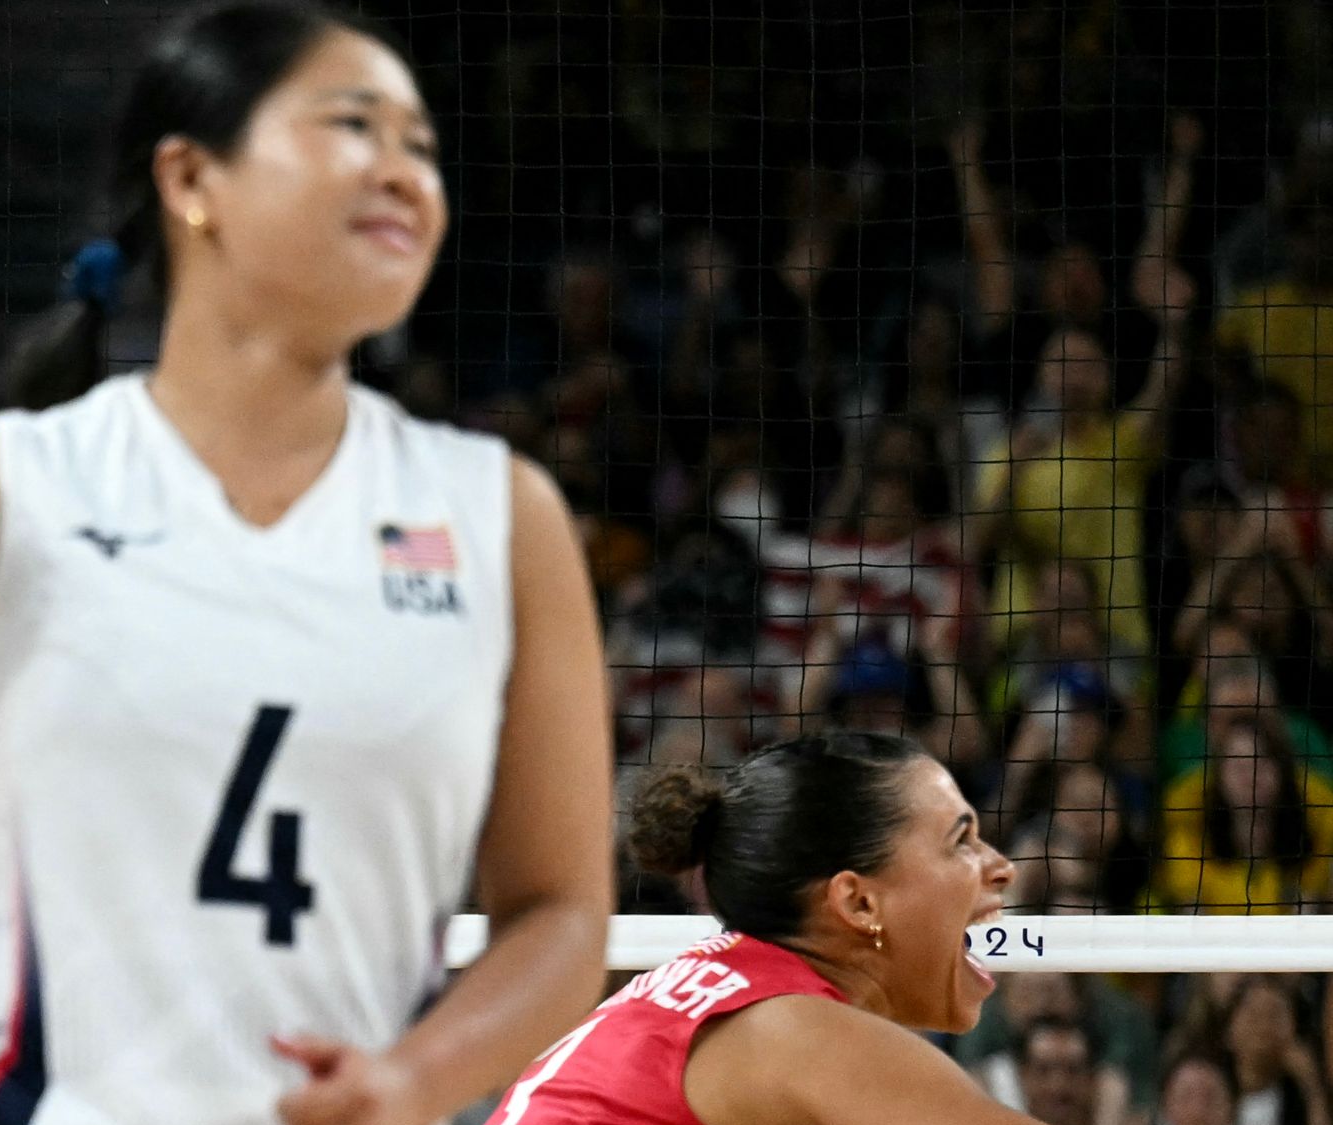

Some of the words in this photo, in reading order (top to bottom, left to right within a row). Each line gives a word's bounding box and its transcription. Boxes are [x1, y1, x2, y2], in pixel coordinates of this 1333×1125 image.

[380, 572, 469, 617] USA
[191, 702, 317, 948] 4
[964, 927, 1043, 957] 24
